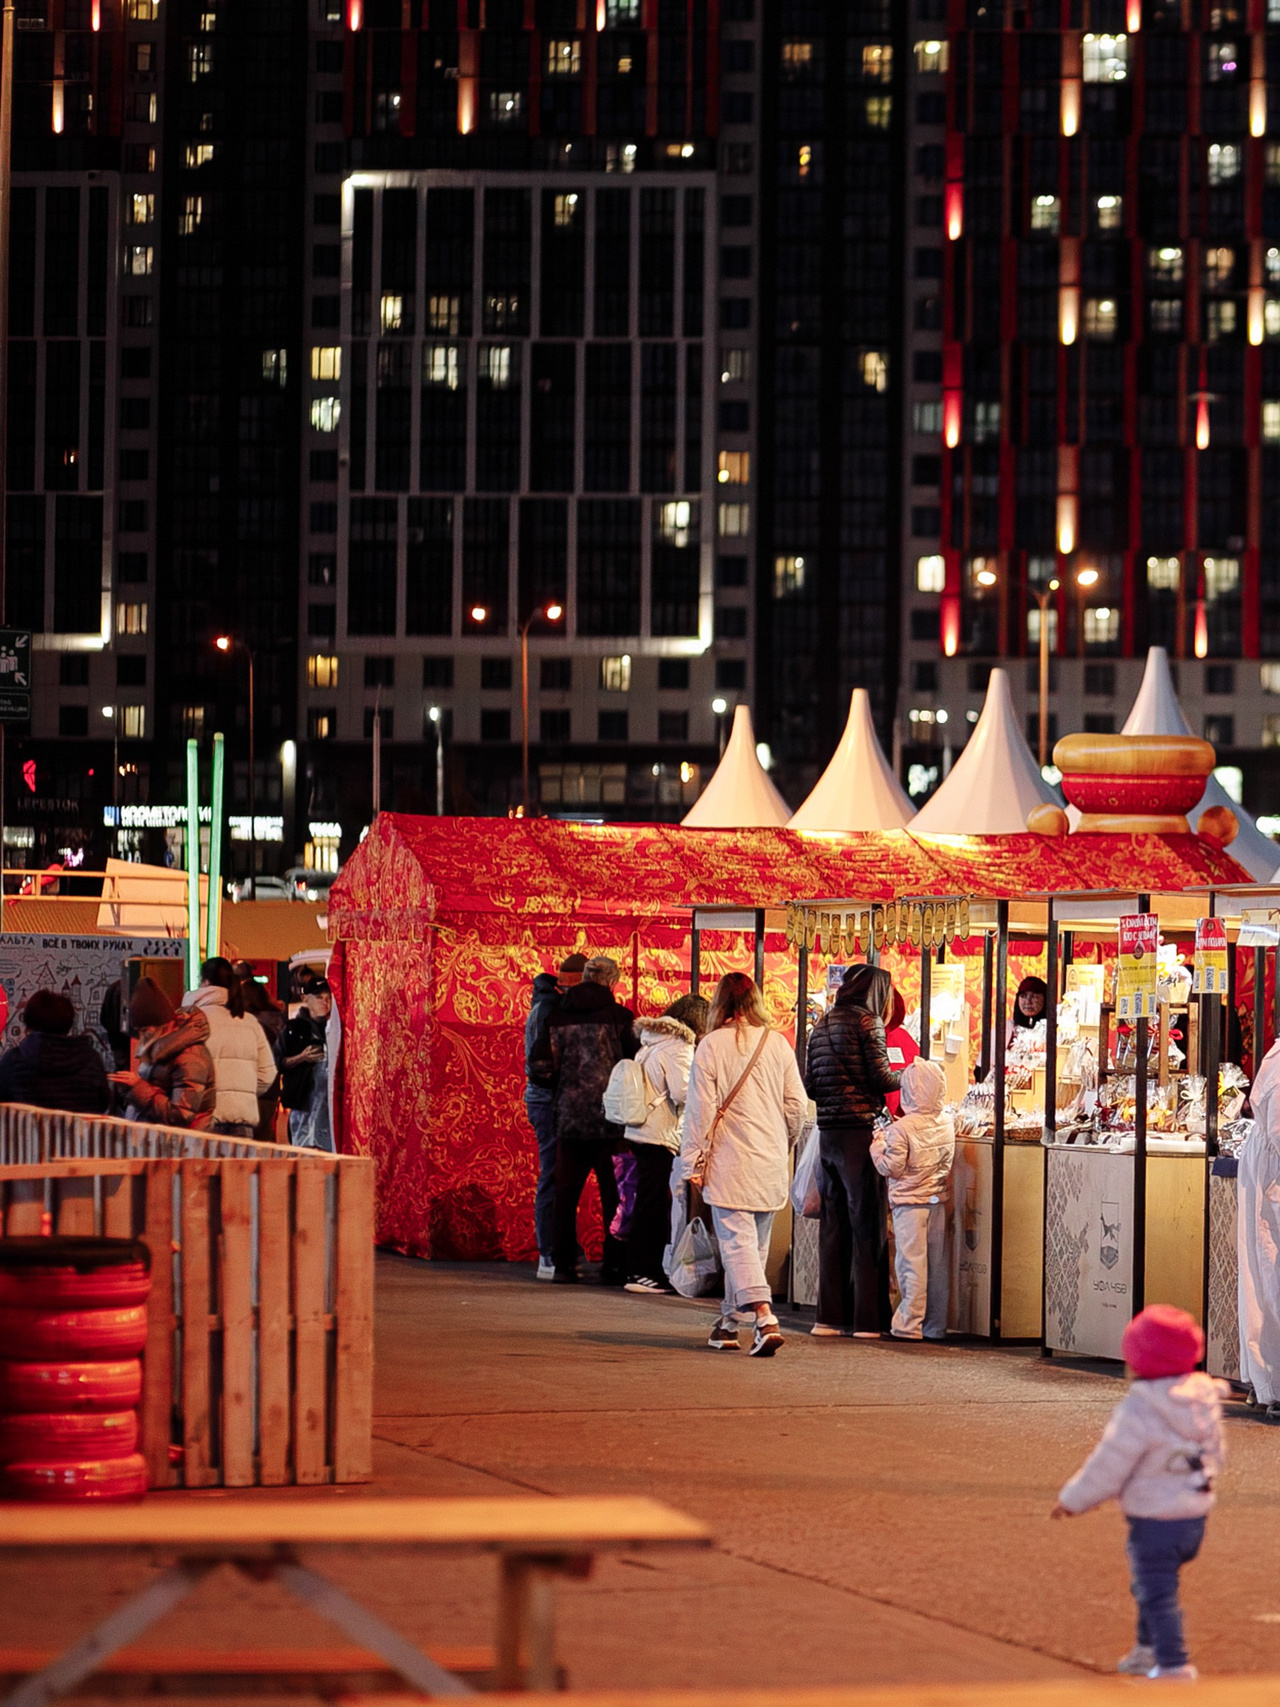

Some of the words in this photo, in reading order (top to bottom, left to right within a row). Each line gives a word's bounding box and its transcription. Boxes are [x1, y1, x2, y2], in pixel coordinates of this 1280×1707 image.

[61, 939, 68, 949] В
[71, 939, 100, 950] ТВОИХ
[103, 939, 134, 951] РУКАХ
